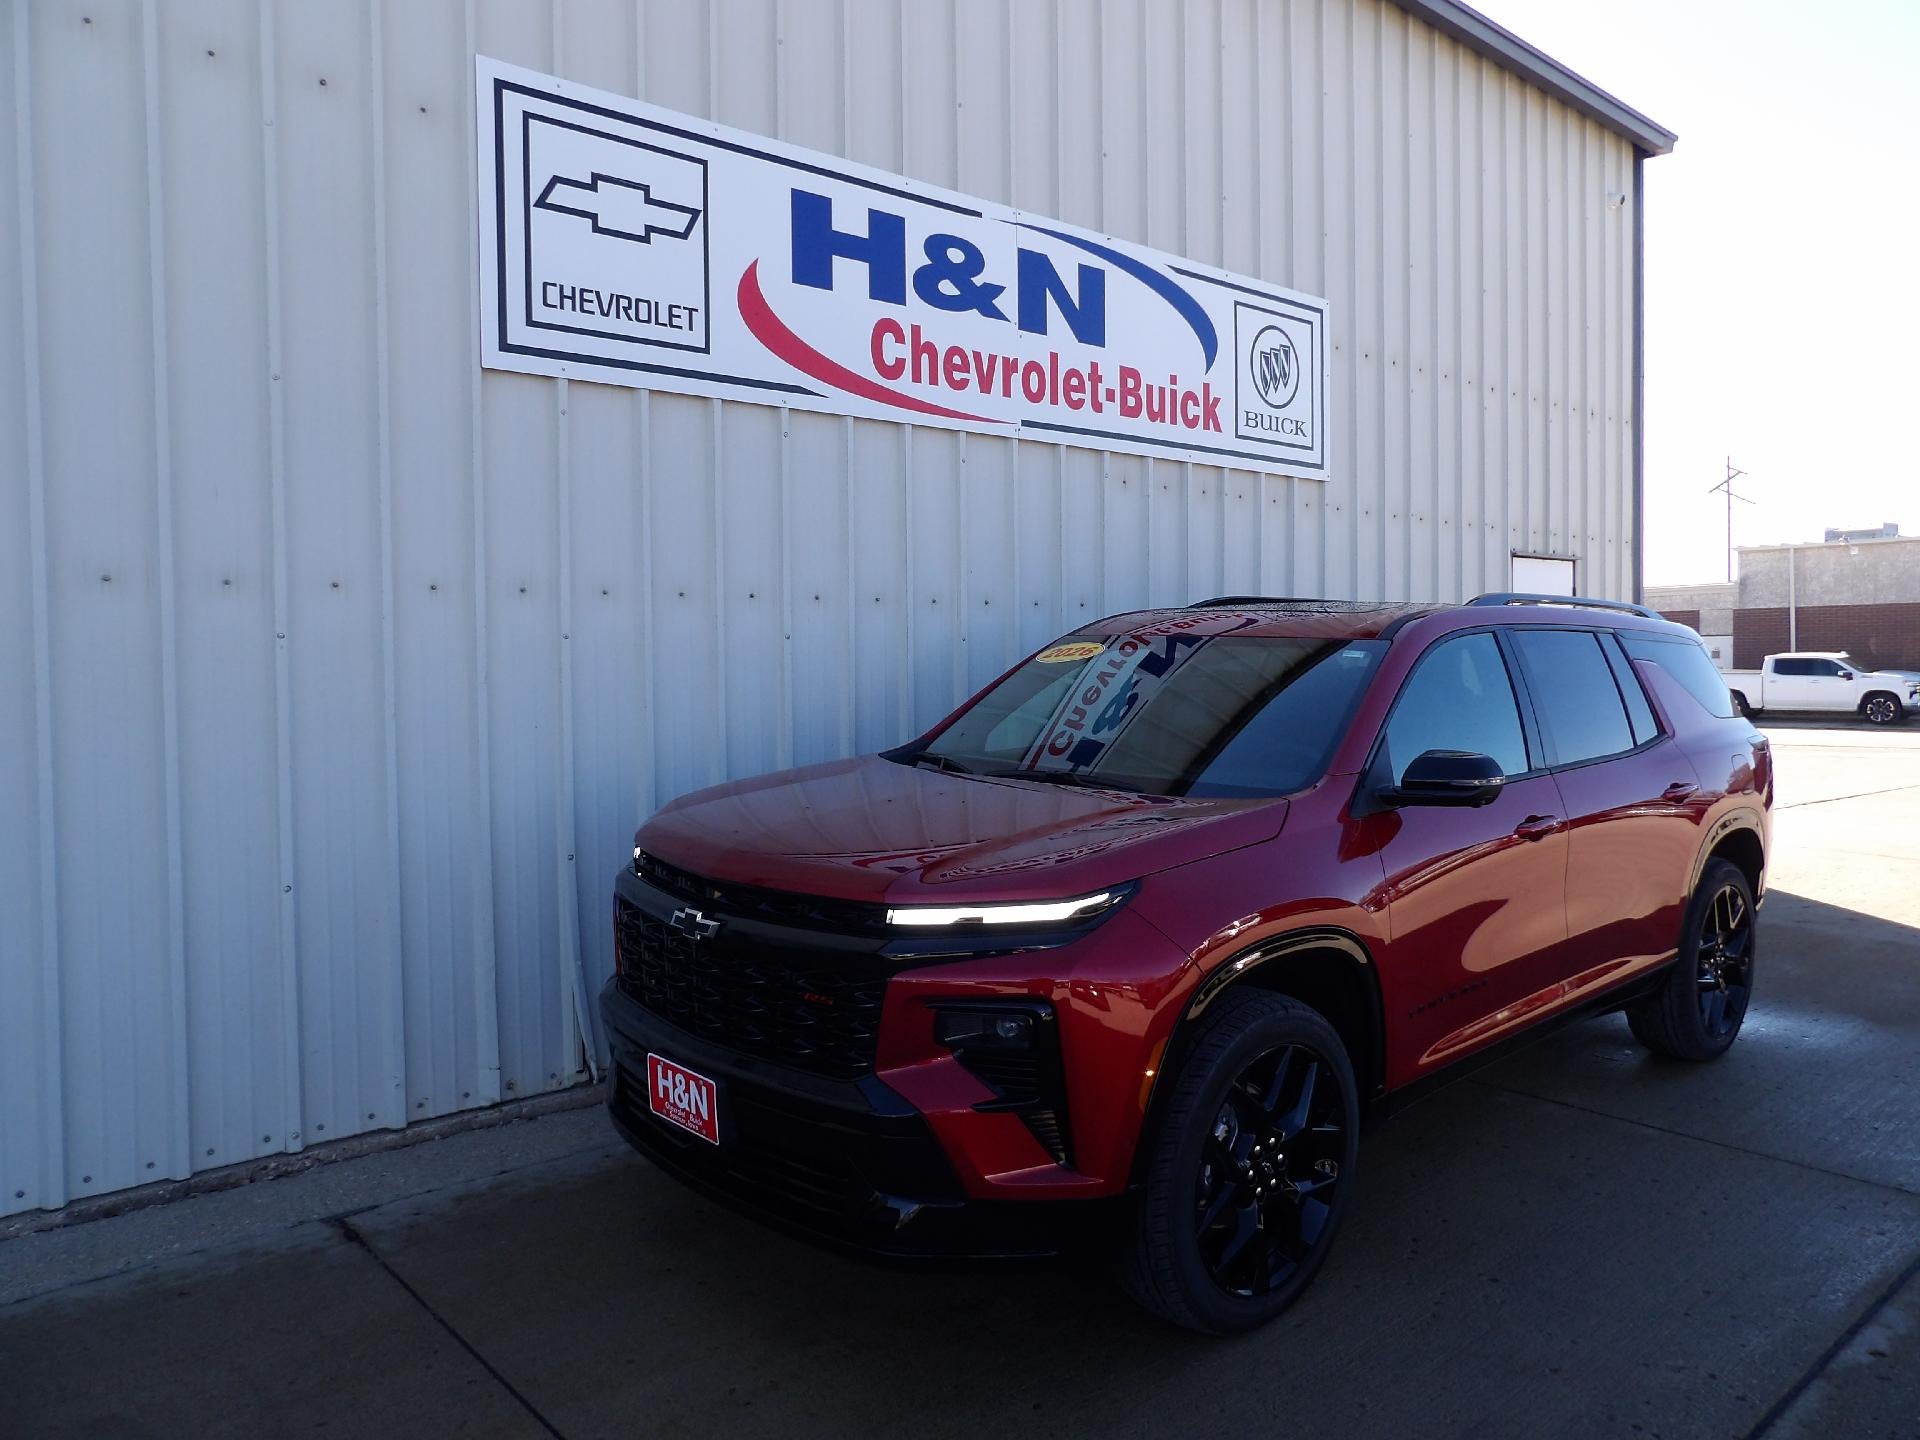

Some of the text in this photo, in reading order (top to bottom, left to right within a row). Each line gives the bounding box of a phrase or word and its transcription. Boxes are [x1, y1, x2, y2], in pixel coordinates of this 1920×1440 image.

[791, 188, 1106, 347] H&N
[542, 281, 699, 332] CHEVROLET
[871, 317, 1224, 433] Chevrolet-Buick
[1243, 410, 1308, 438] BUICK
[657, 1064, 709, 1120] H&N
